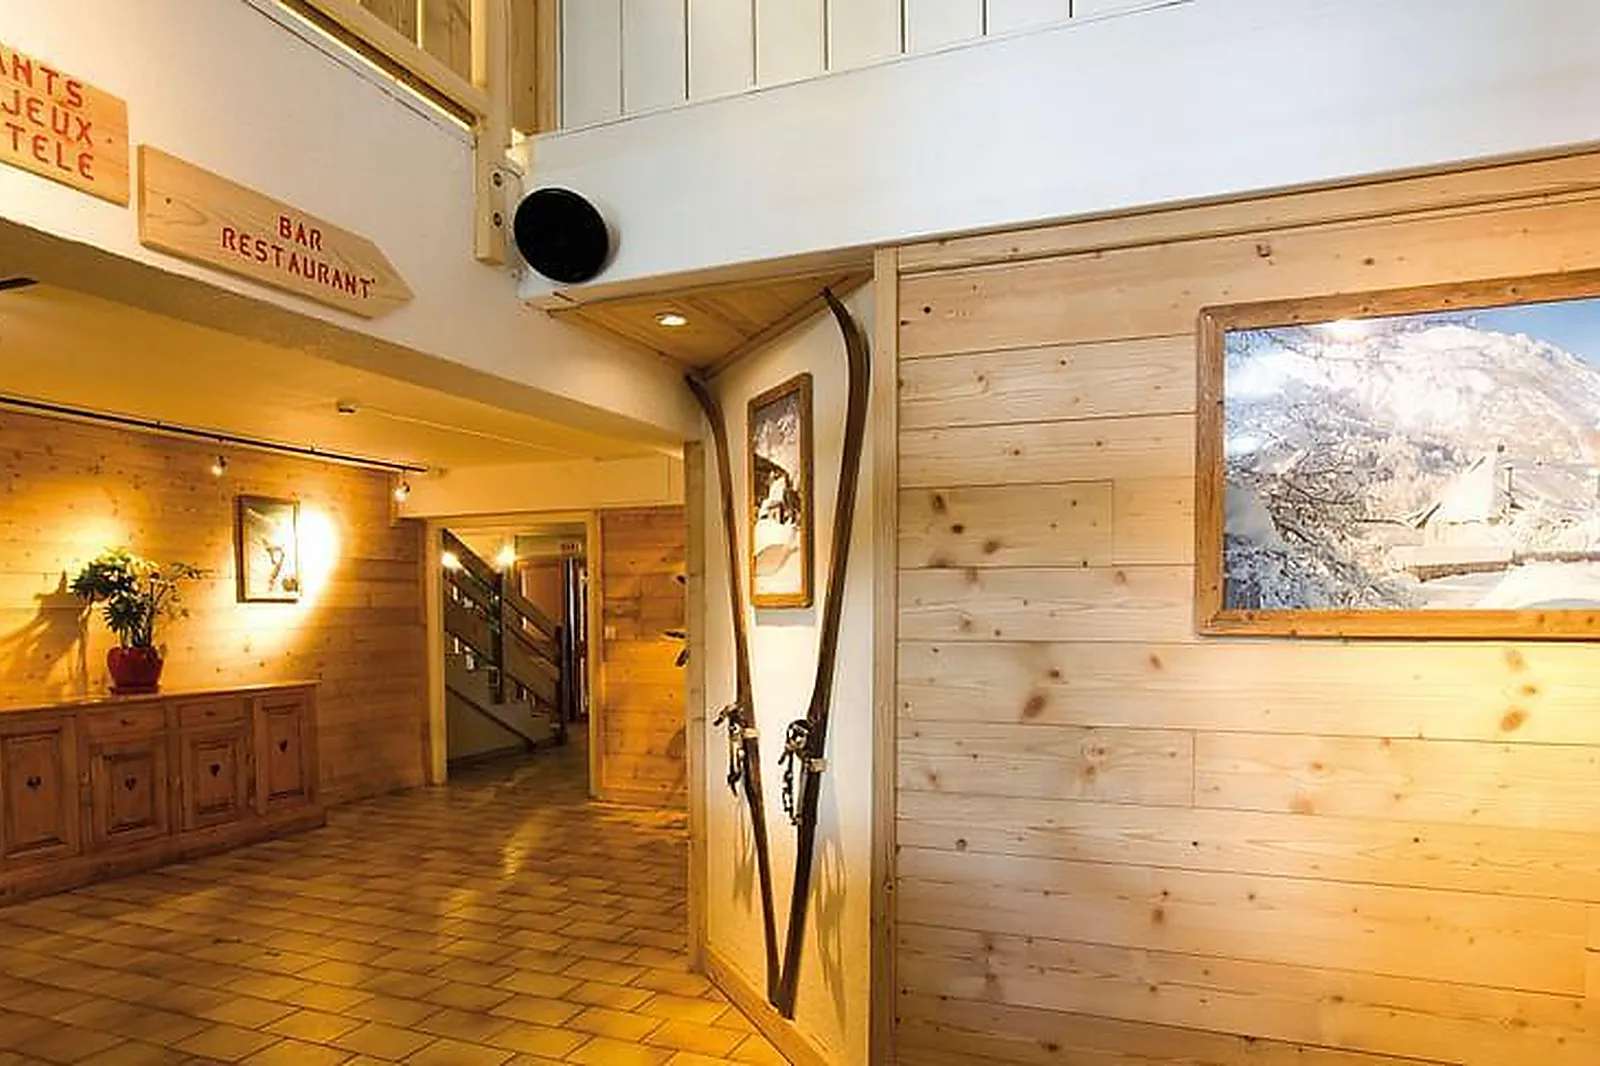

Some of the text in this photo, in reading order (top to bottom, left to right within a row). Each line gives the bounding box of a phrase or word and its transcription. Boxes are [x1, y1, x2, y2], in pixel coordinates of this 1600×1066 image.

[1, 89, 94, 148] JEUX
[5, 121, 94, 181] TELE
[221, 227, 371, 299] RESTAURANT
[279, 215, 322, 252] BAR
